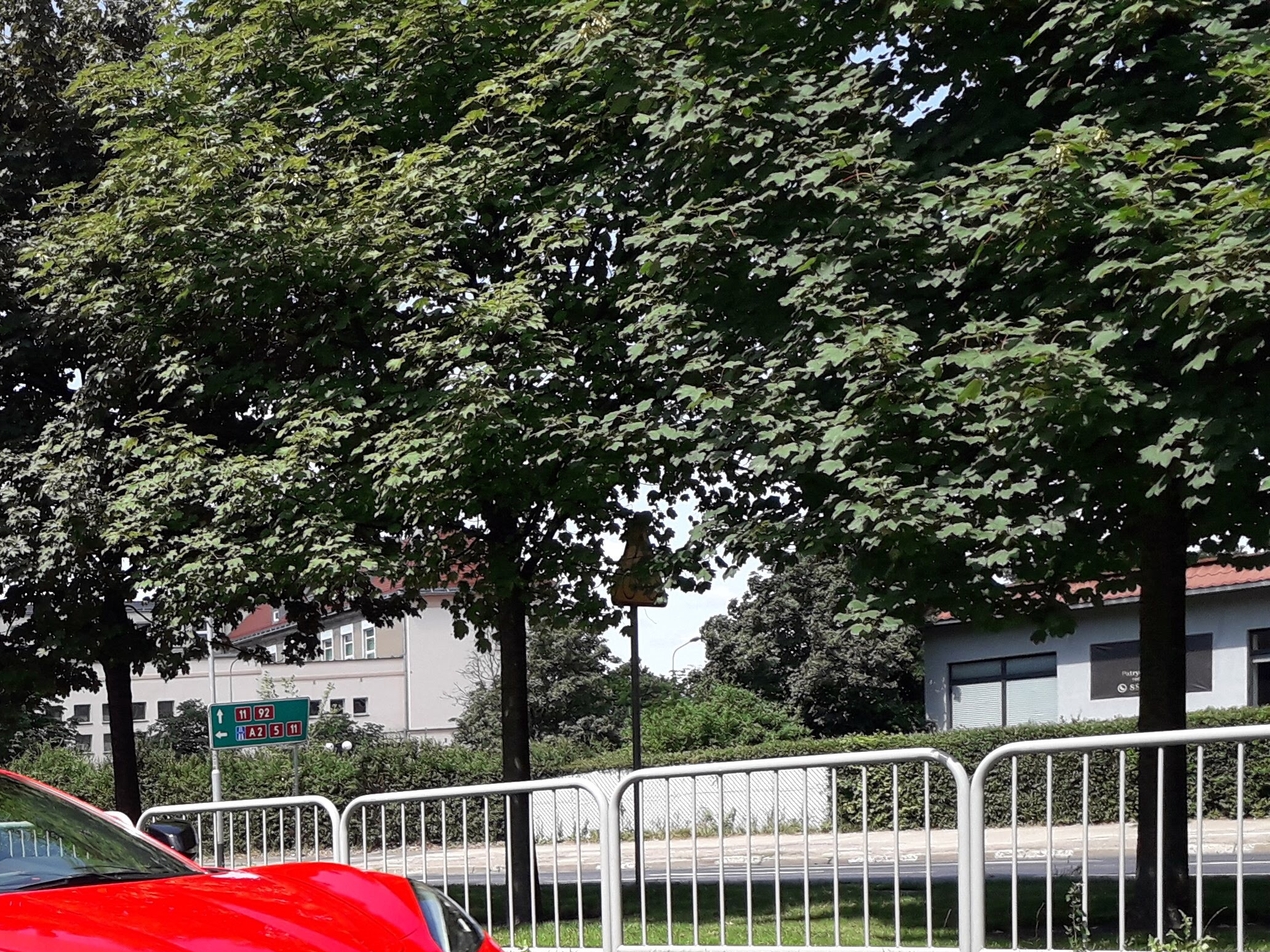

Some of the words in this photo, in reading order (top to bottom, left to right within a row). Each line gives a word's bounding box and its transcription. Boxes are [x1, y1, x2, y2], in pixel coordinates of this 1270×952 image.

[239, 709, 247, 719] 11
[258, 708, 270, 718] 92
[274, 725, 279, 736] 5
[290, 723, 298, 734] 11
